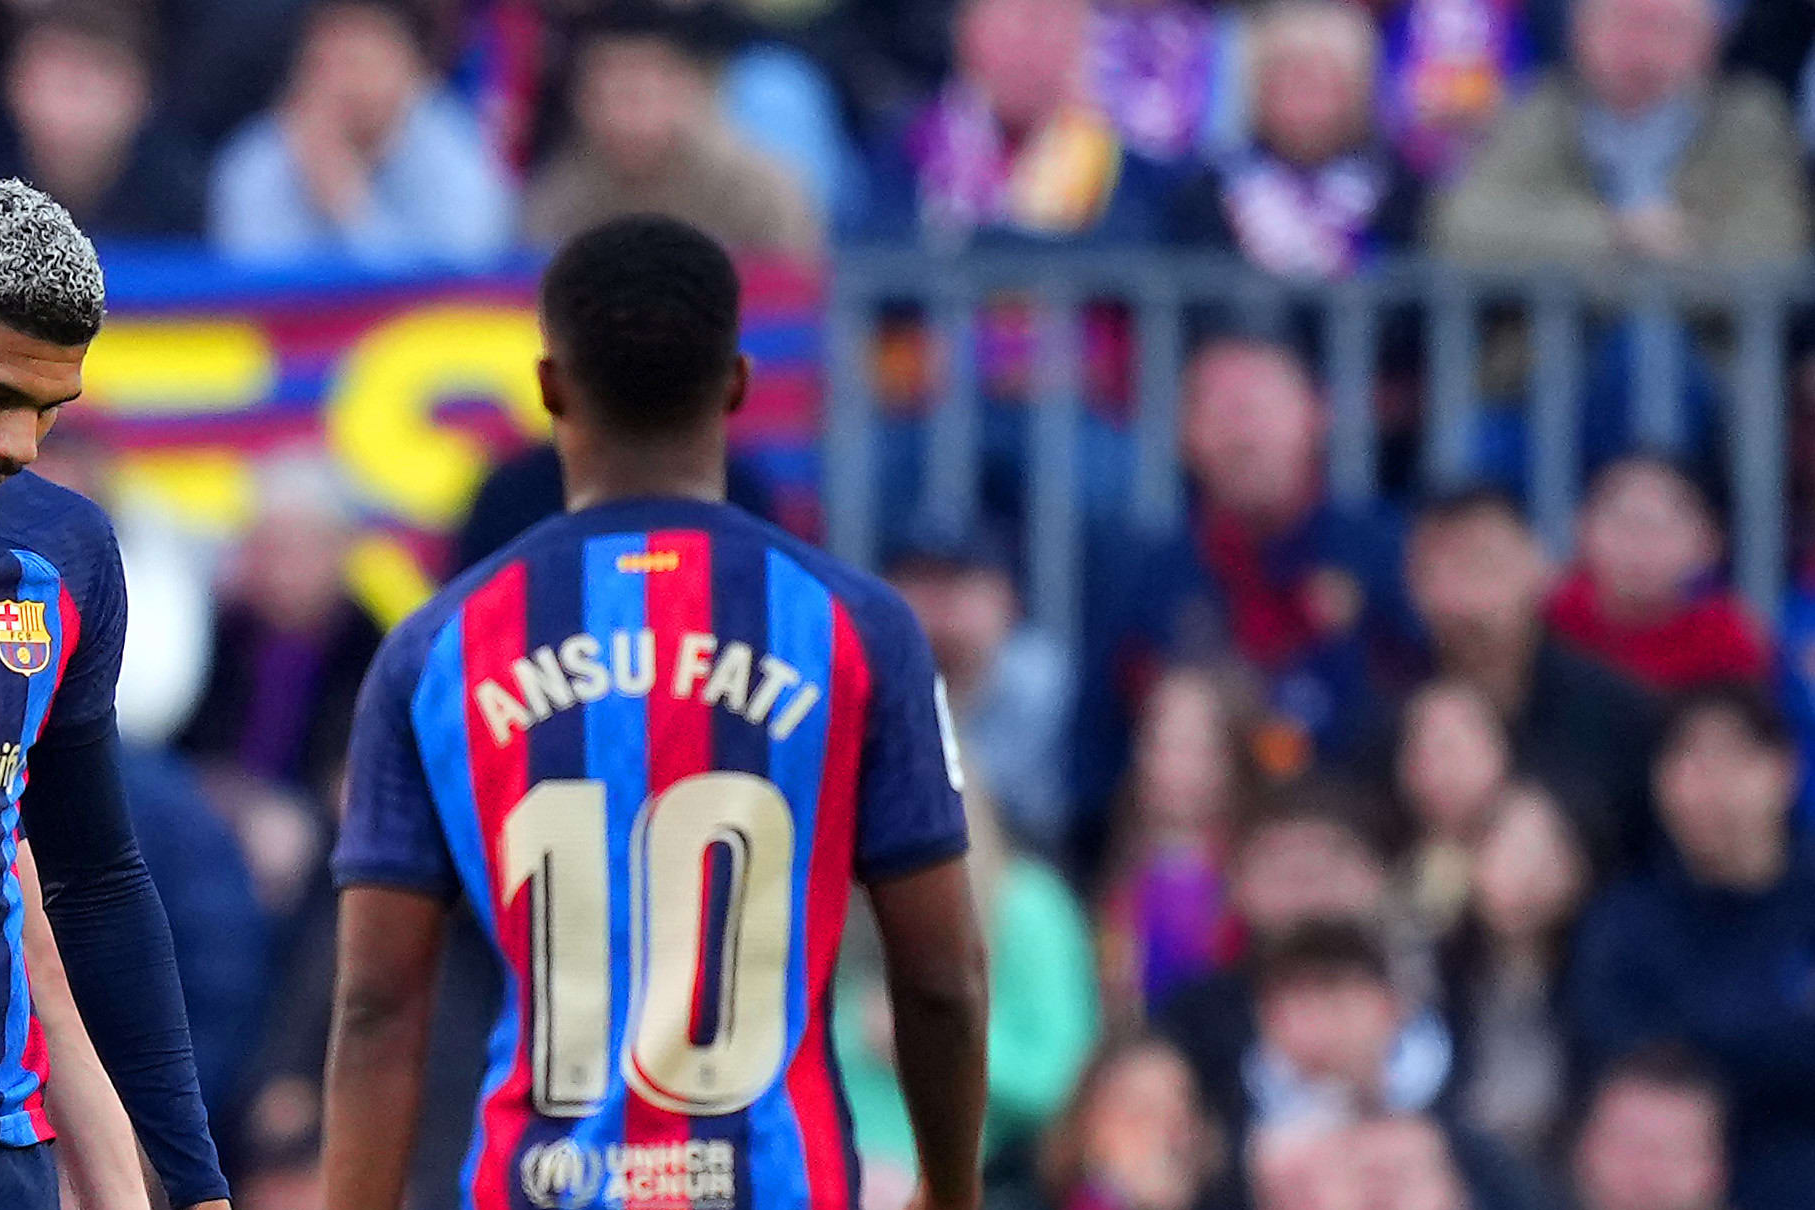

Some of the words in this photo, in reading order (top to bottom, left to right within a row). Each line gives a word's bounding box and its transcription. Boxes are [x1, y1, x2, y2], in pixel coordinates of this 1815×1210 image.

[474, 630, 656, 746] ANSU
[673, 632, 820, 741] FATI
[499, 771, 795, 1117] 10
